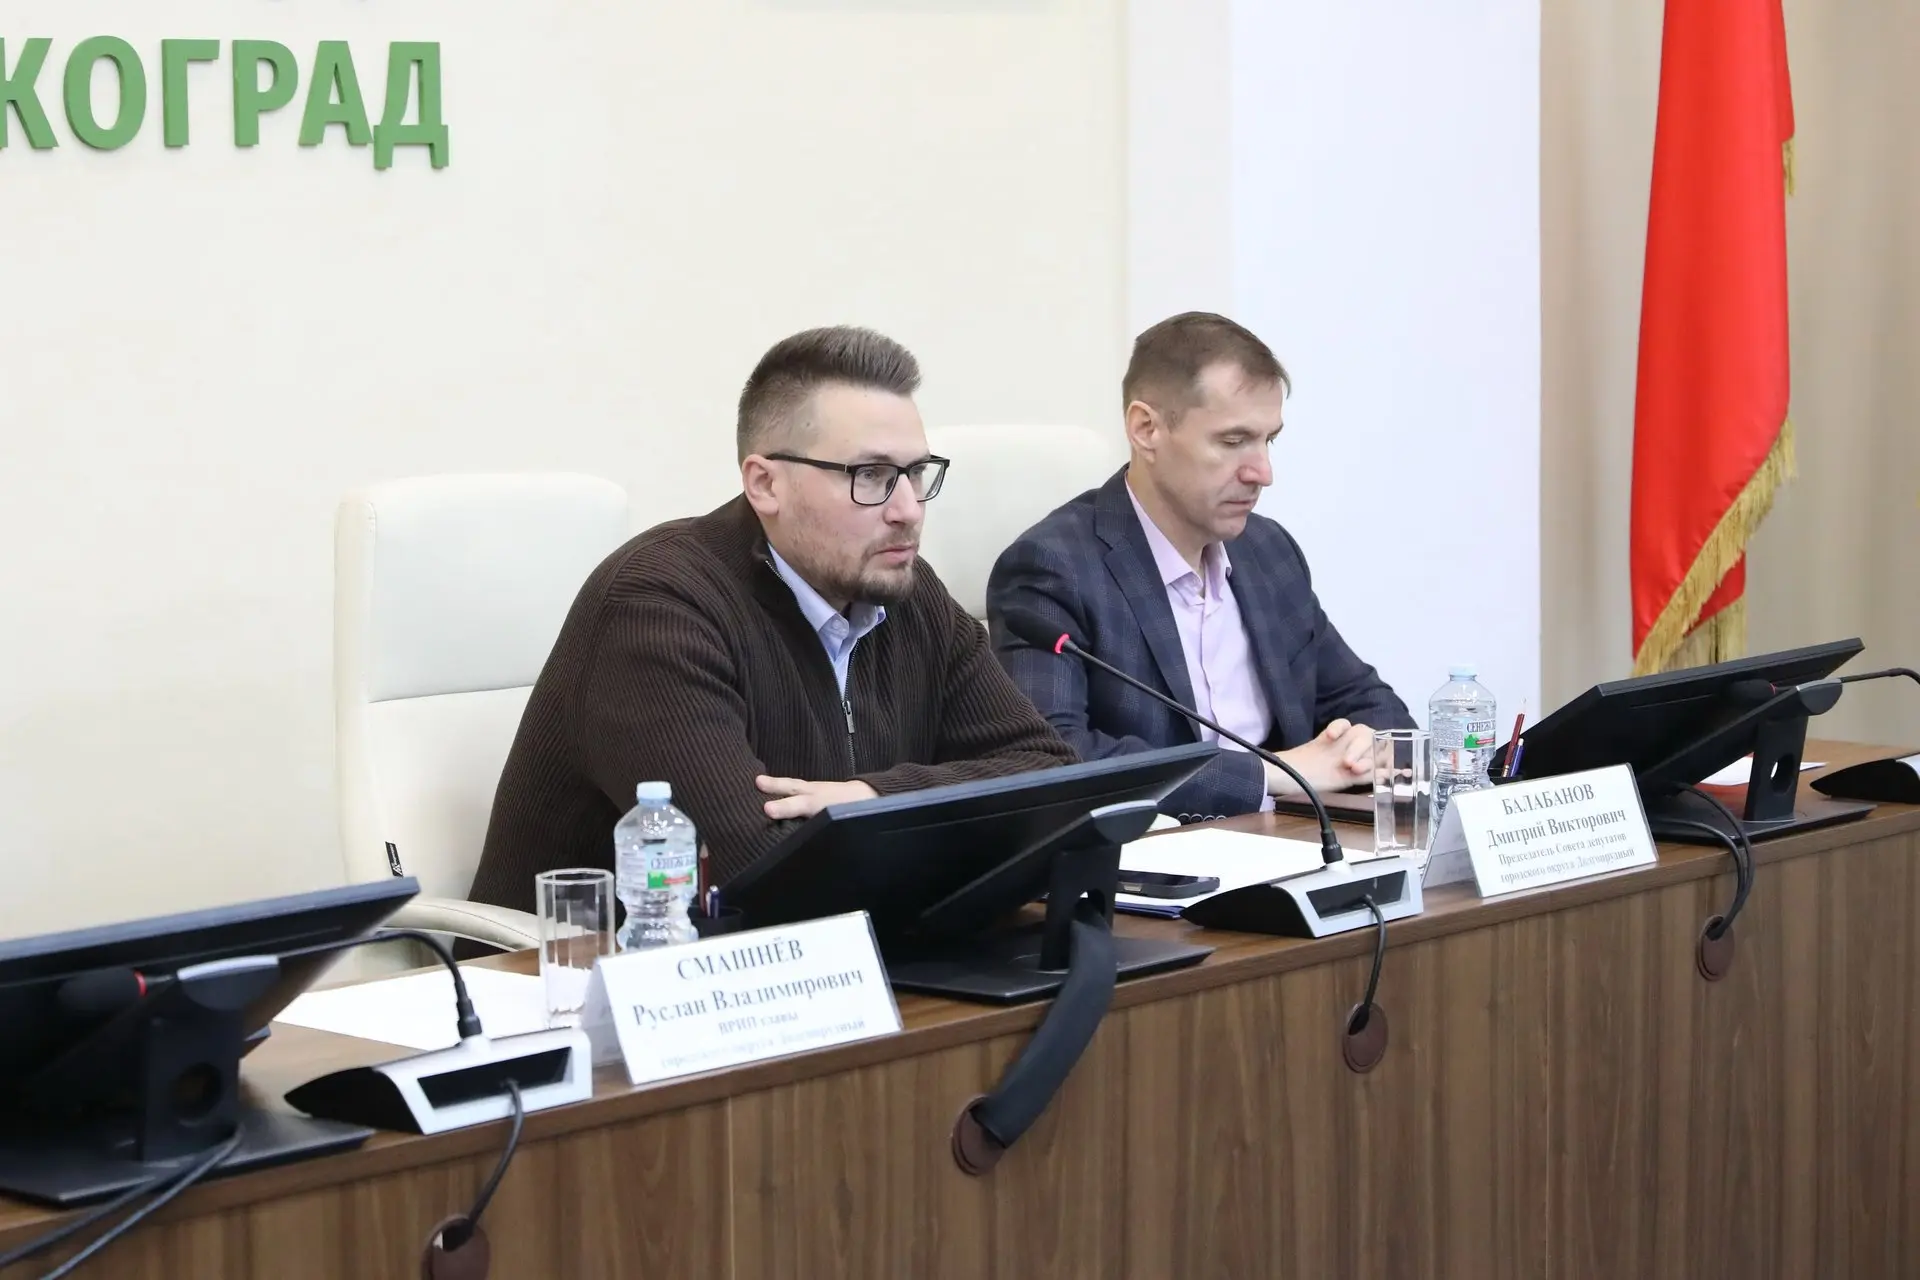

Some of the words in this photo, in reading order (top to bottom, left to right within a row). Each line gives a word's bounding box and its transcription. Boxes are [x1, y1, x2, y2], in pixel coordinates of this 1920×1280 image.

[1502, 783, 1595, 816] БАЛАБАНОВ
[1486, 821, 1546, 849] Дмитрий
[1547, 809, 1627, 836] Викторович
[1498, 849, 1555, 867] Председатель
[1556, 840, 1585, 855] Совета
[1587, 832, 1627, 850] депутатов
[1500, 866, 1546, 885] городского
[677, 937, 804, 981] СМАШНЁВ
[632, 998, 708, 1030] Руслан
[710, 968, 866, 1011] Владимирович
